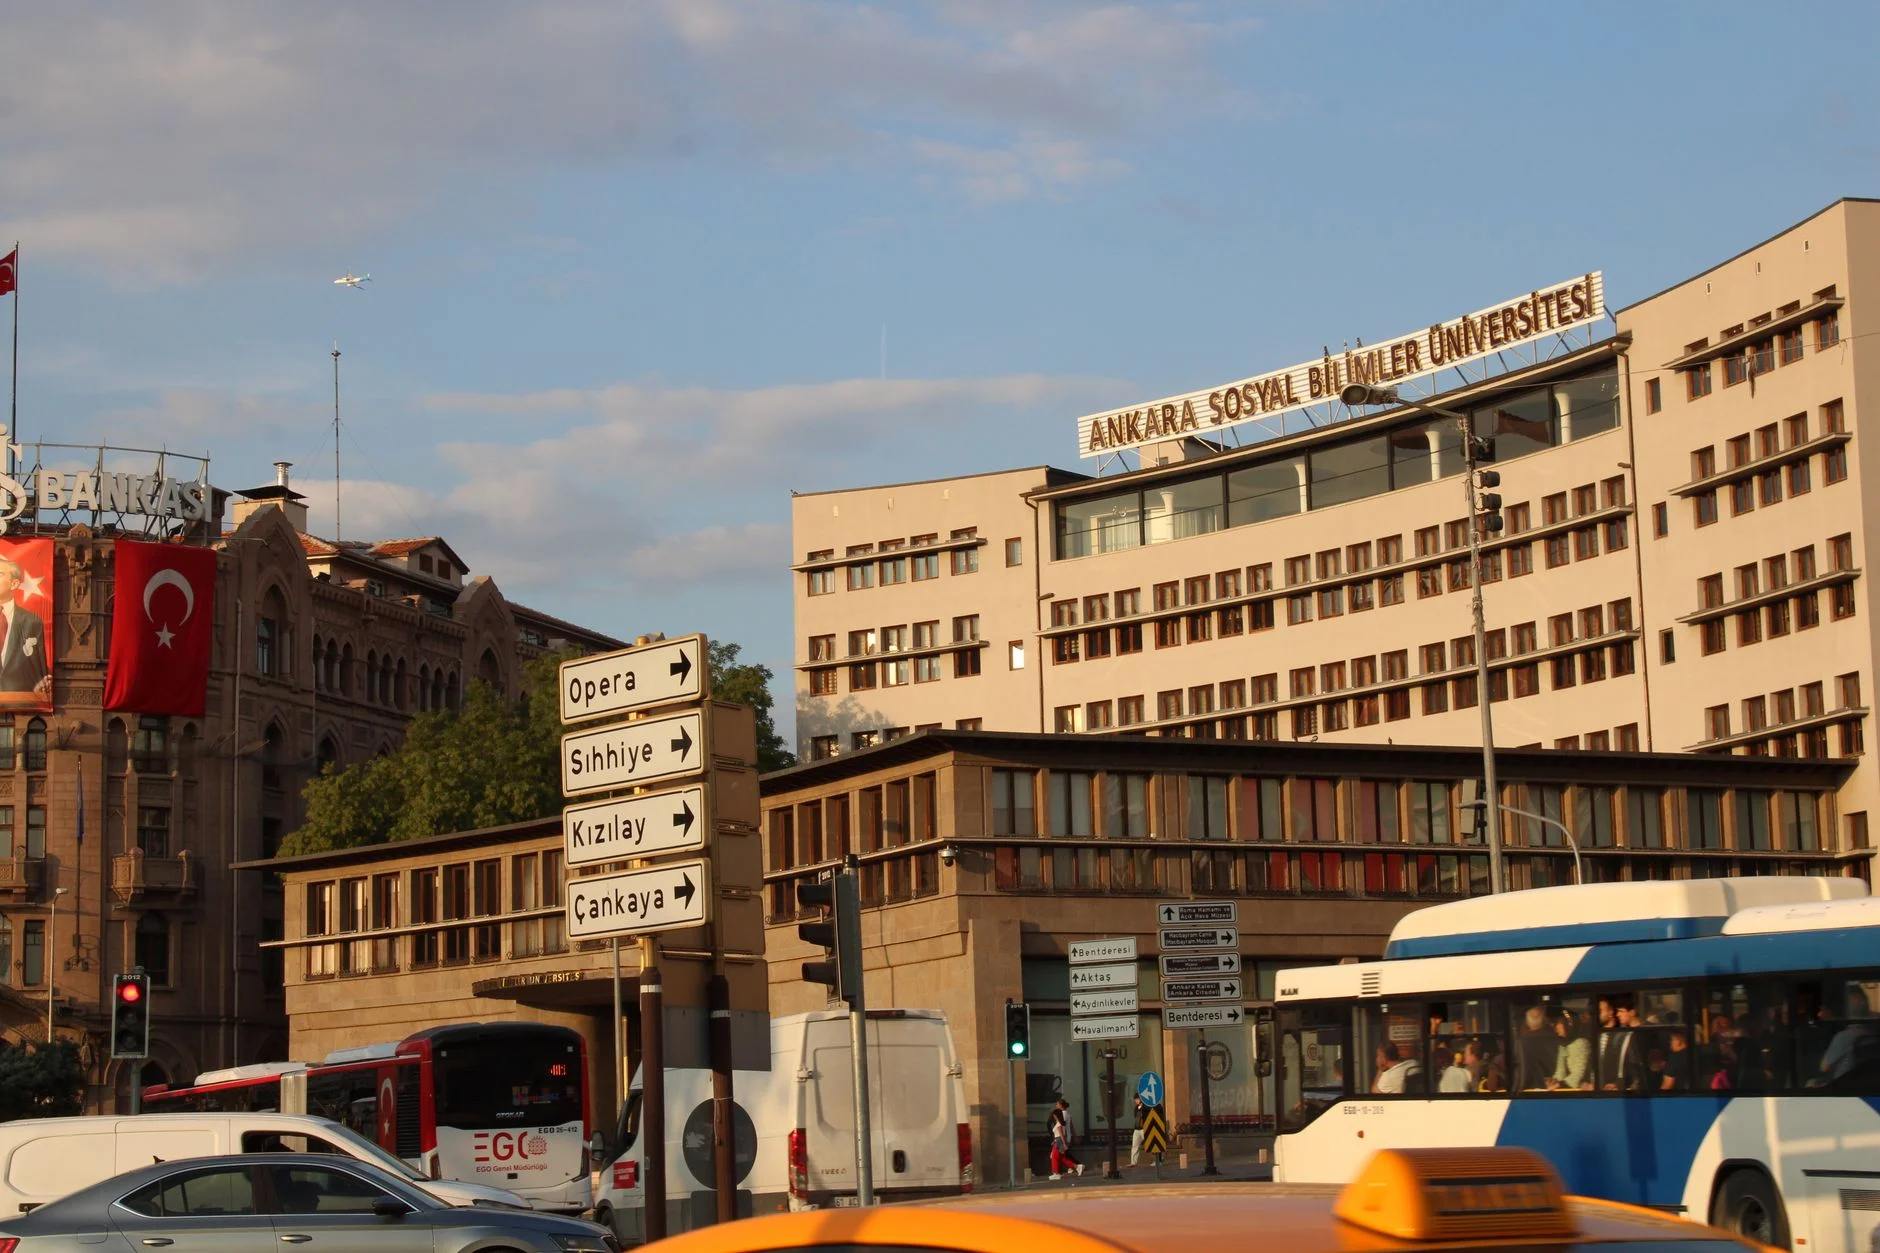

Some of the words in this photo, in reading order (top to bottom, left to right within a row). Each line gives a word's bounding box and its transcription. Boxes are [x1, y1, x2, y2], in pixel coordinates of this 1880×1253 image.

[1089, 400, 1198, 451] ANKARA
[1208, 374, 1299, 425] SOSYAL
[1308, 340, 1423, 399] BİLİMLER
[1429, 273, 1596, 367] ÜNİVERSİTESİ
[40, 470, 213, 523] BANKASI
[569, 671, 636, 708] Opera
[571, 741, 653, 775] Sıhhiye
[572, 814, 646, 848] Kızılay
[574, 888, 664, 925] Çankaya
[1080, 973, 1111, 983] Aktaş
[1168, 1010, 1223, 1023] Bentderesi
